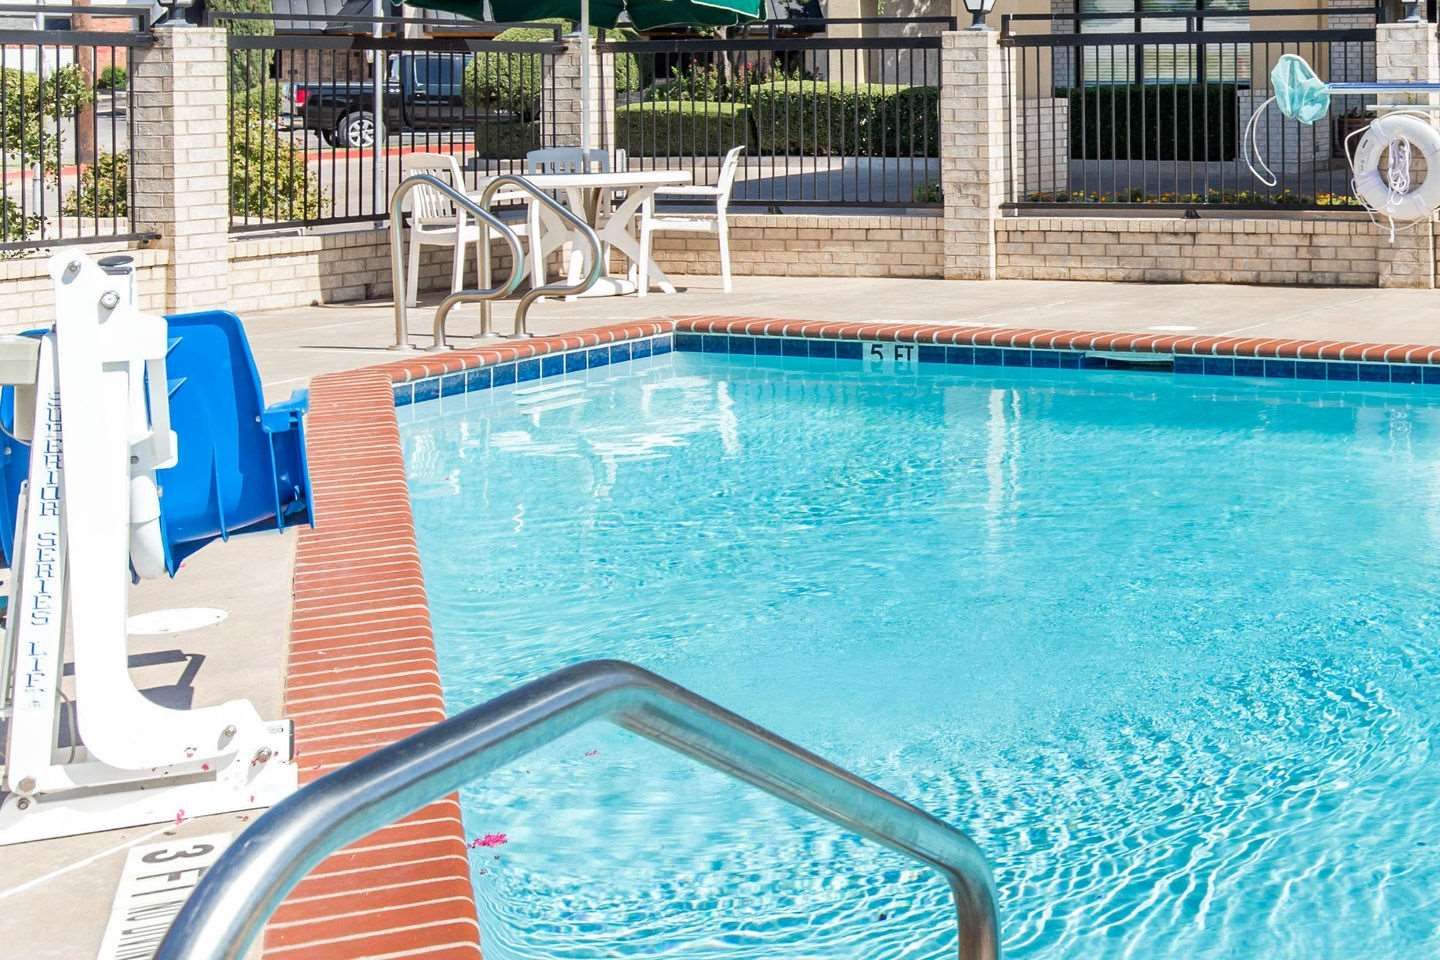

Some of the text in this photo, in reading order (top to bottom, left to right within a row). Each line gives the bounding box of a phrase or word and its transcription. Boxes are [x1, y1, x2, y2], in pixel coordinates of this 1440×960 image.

[871, 343, 915, 361] 5 FT
[31, 531, 57, 626] SERIES
[141, 843, 215, 864] 3
